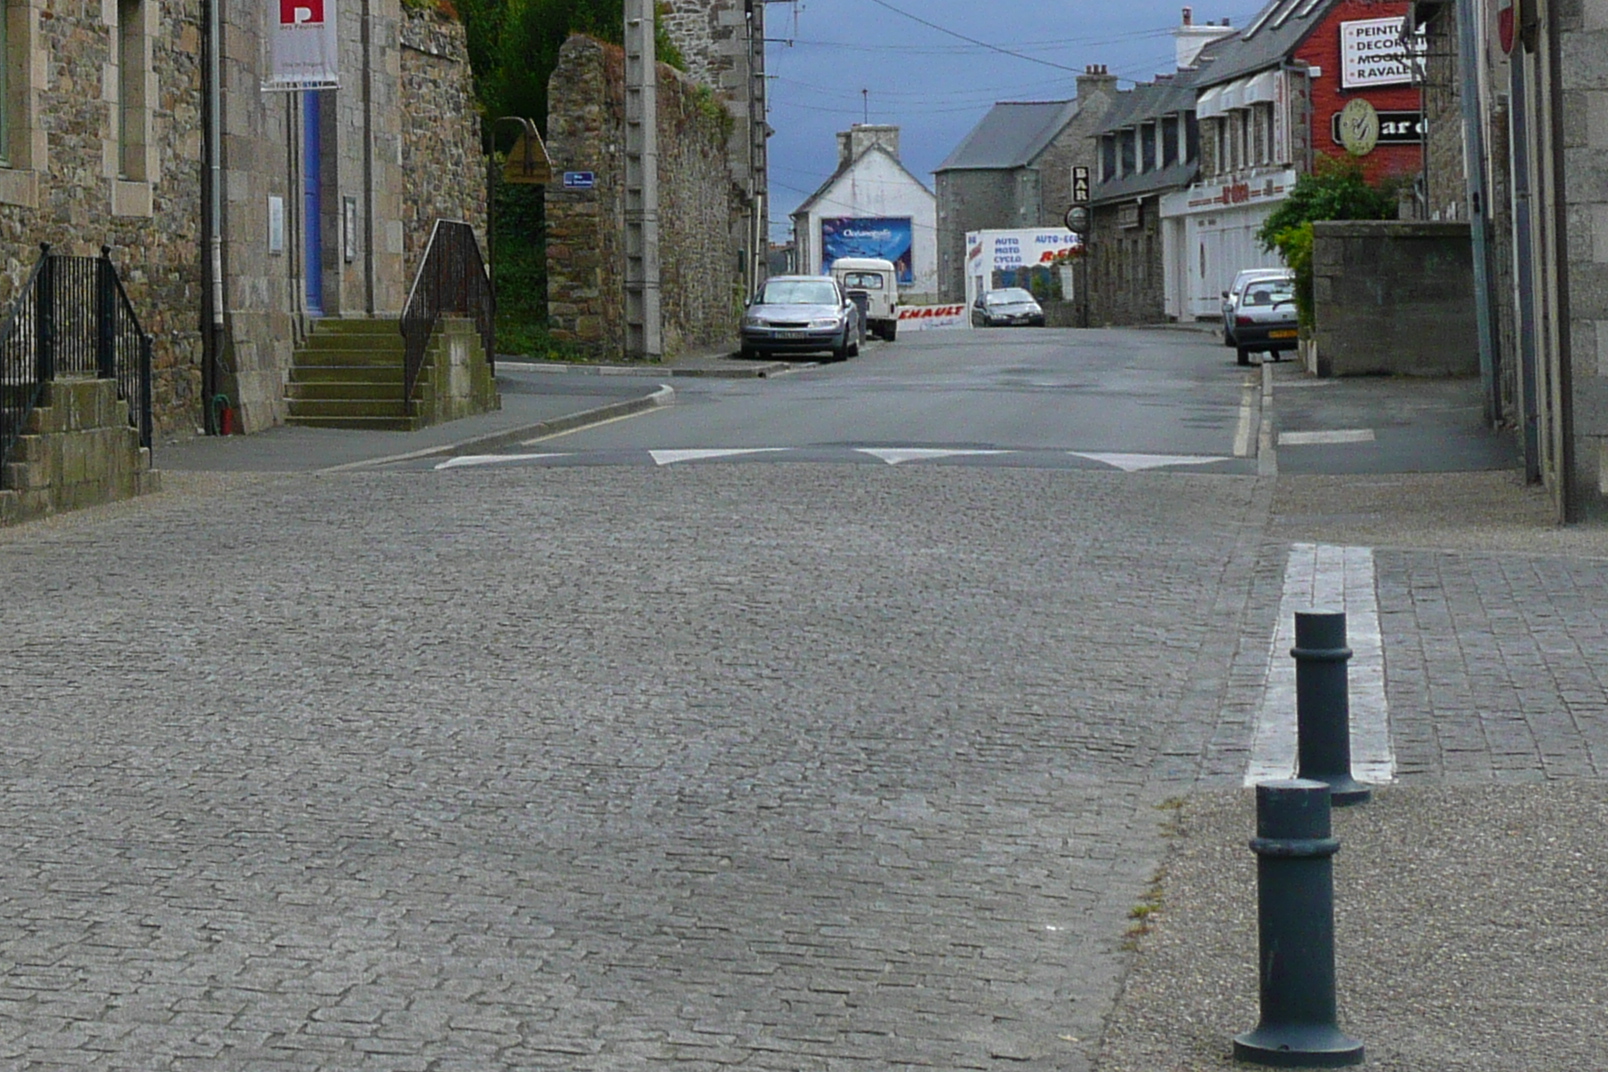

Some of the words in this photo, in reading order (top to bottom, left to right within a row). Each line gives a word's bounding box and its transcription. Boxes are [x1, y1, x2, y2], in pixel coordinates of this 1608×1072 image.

[1356, 25, 1403, 37] PEINTU
[1357, 66, 1410, 79] RAVALE
[1075, 168, 1088, 201] BAR
[995, 238, 1019, 246] AUTO
[995, 247, 1020, 255] MOTO
[898, 305, 965, 320] ENAULT
